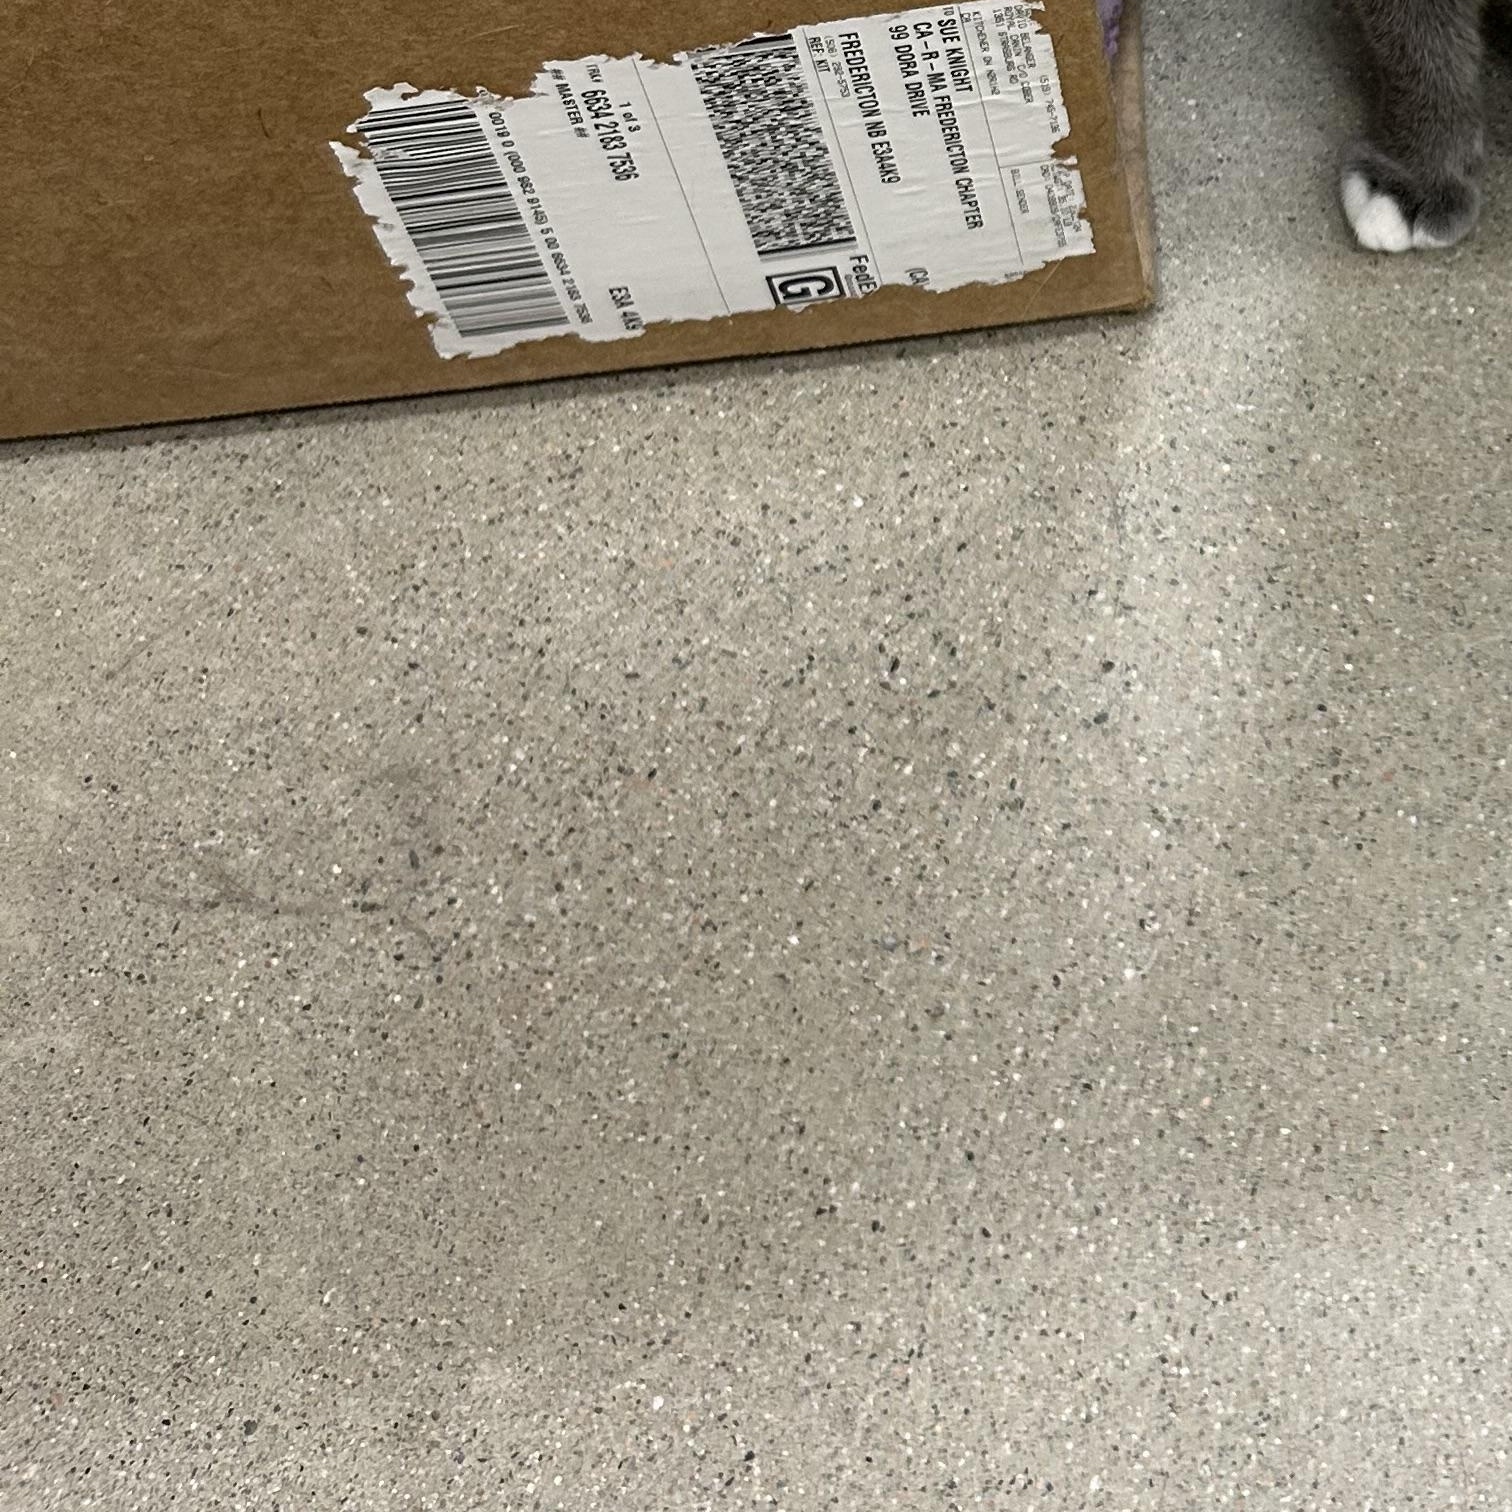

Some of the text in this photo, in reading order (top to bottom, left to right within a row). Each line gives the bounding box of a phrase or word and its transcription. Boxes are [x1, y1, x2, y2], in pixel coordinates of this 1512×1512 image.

[938, 19, 961, 44] SUE
[1003, 6, 1016, 31] ROYAL
[1014, 5, 1027, 29] DAVID
[815, 59, 830, 72] KIT
[889, 25, 930, 117] 99 DORA DRIVE
[945, 47, 973, 94] KNIGHT
[555, 83, 584, 125] MASTER
[581, 89, 615, 119] 6634
[622, 112, 638, 122] of
[838, 32, 901, 184] FREDERICTON NB E3A4K9
[594, 120, 627, 151] 2183
[628, 125, 641, 133] 3
[607, 152, 639, 181] 7536
[933, 95, 970, 175] FREDERICTON
[955, 177, 984, 230] CHAPTER
[778, 275, 837, 302] G
